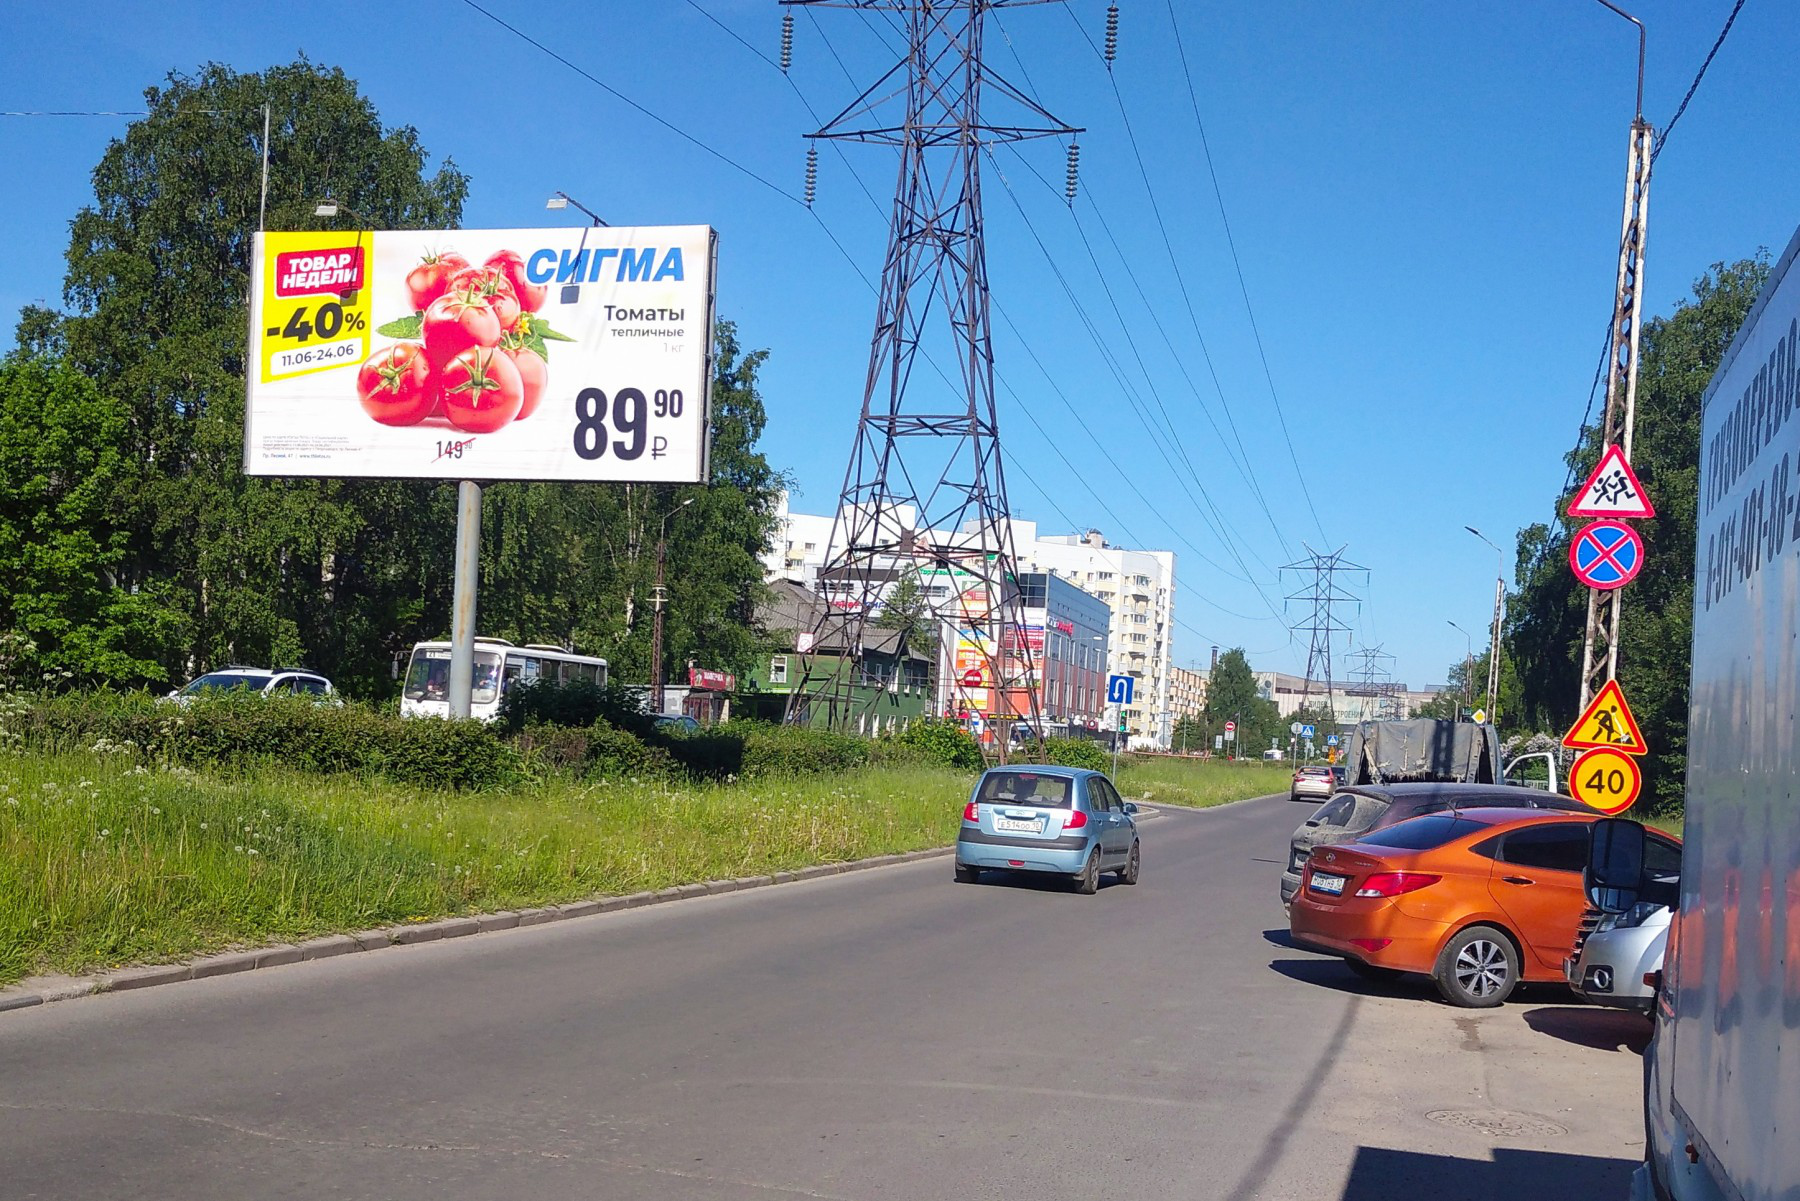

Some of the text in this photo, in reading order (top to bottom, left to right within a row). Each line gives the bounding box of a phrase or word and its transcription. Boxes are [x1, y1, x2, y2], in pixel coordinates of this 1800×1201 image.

[288, 253, 352, 273] ТОВАР
[526, 247, 685, 284] СИГМА
[282, 266, 358, 289] НЕДЕЛИ
[266, 302, 366, 343] -40%
[603, 305, 685, 321] Томаты
[611, 328, 685, 338] тепличные
[281, 343, 355, 367] 11.06-24.06
[671, 344, 685, 354] кг
[573, 387, 684, 461] 89 90
[435, 440, 464, 459] 149
[1585, 768, 1625, 795] 40
